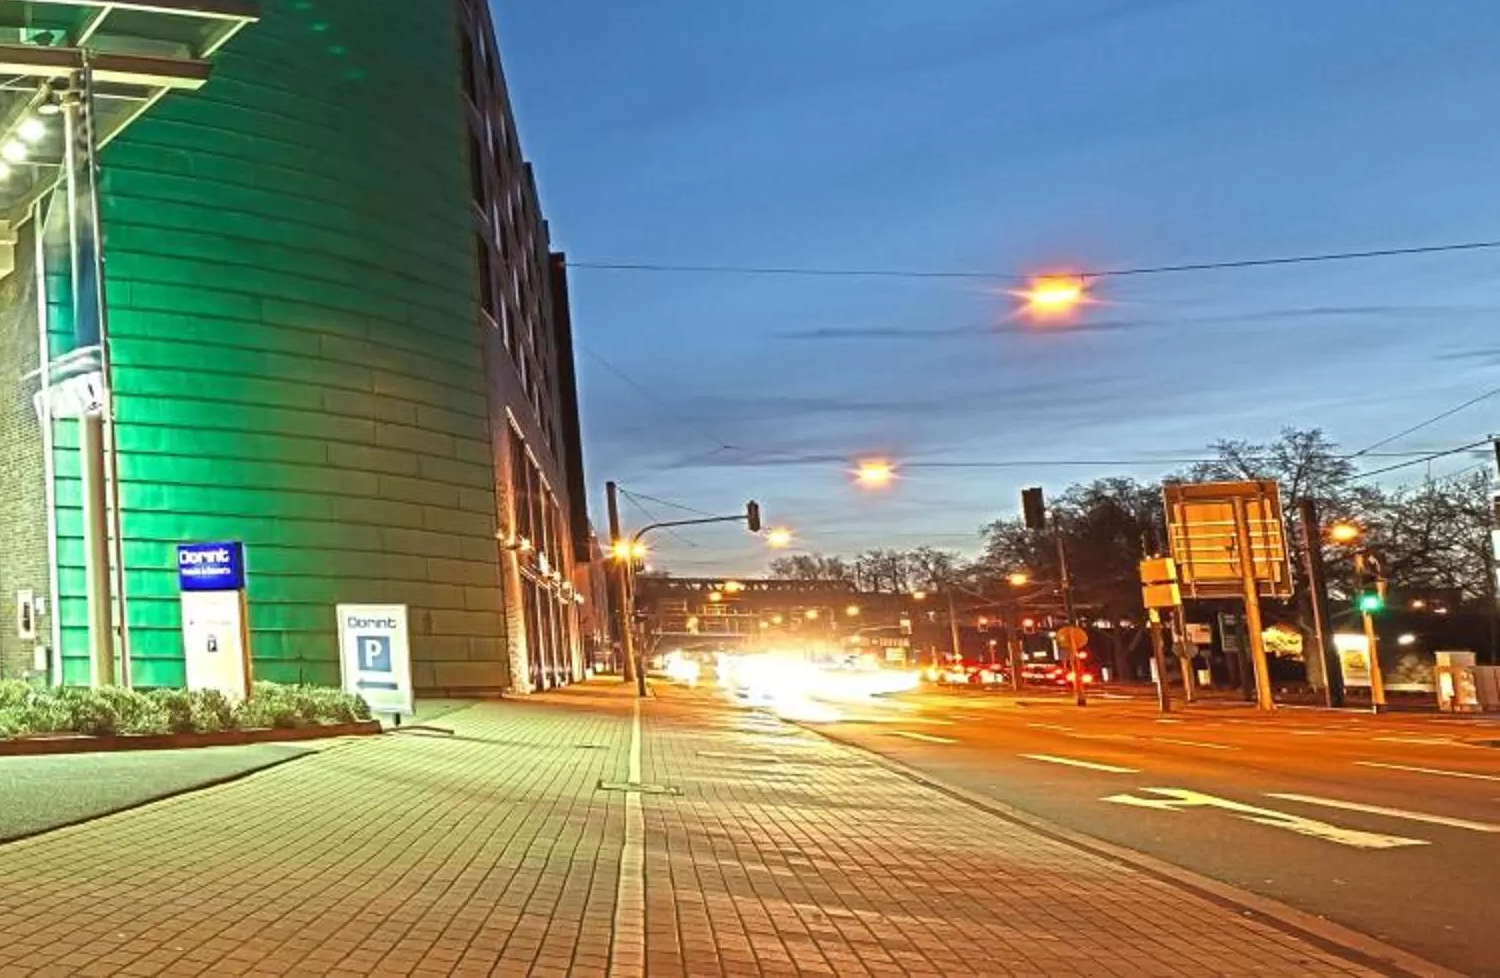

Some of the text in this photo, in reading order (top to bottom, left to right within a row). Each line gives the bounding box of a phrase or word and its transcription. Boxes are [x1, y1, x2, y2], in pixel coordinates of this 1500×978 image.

[179, 548, 230, 564] Dorint
[347, 616, 397, 629] Dorint
[365, 639, 382, 668] P
